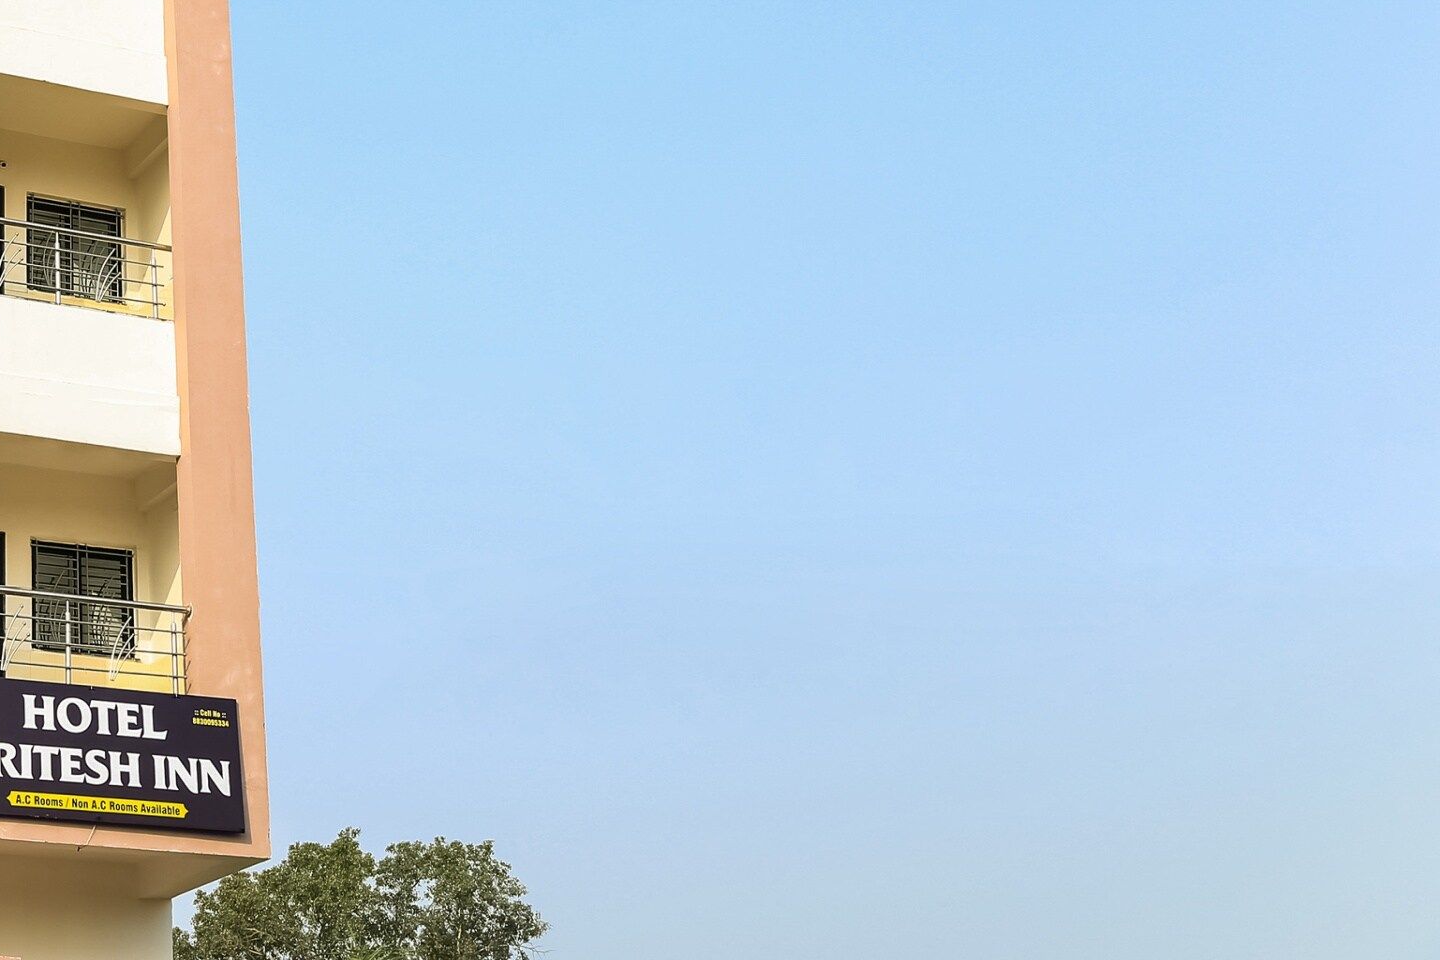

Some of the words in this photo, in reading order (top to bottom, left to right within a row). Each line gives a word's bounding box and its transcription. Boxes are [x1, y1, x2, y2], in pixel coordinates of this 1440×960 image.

[22, 694, 168, 740] HOTEL
[200, 709, 211, 717] Cell
[152, 754, 232, 797] INN
[16, 794, 31, 805] A.C
[34, 795, 64, 807] Rooms
[72, 798, 89, 809] Non
[91, 800, 107, 811] A.C
[110, 801, 139, 813] Rooms
[140, 804, 181, 816] Available
